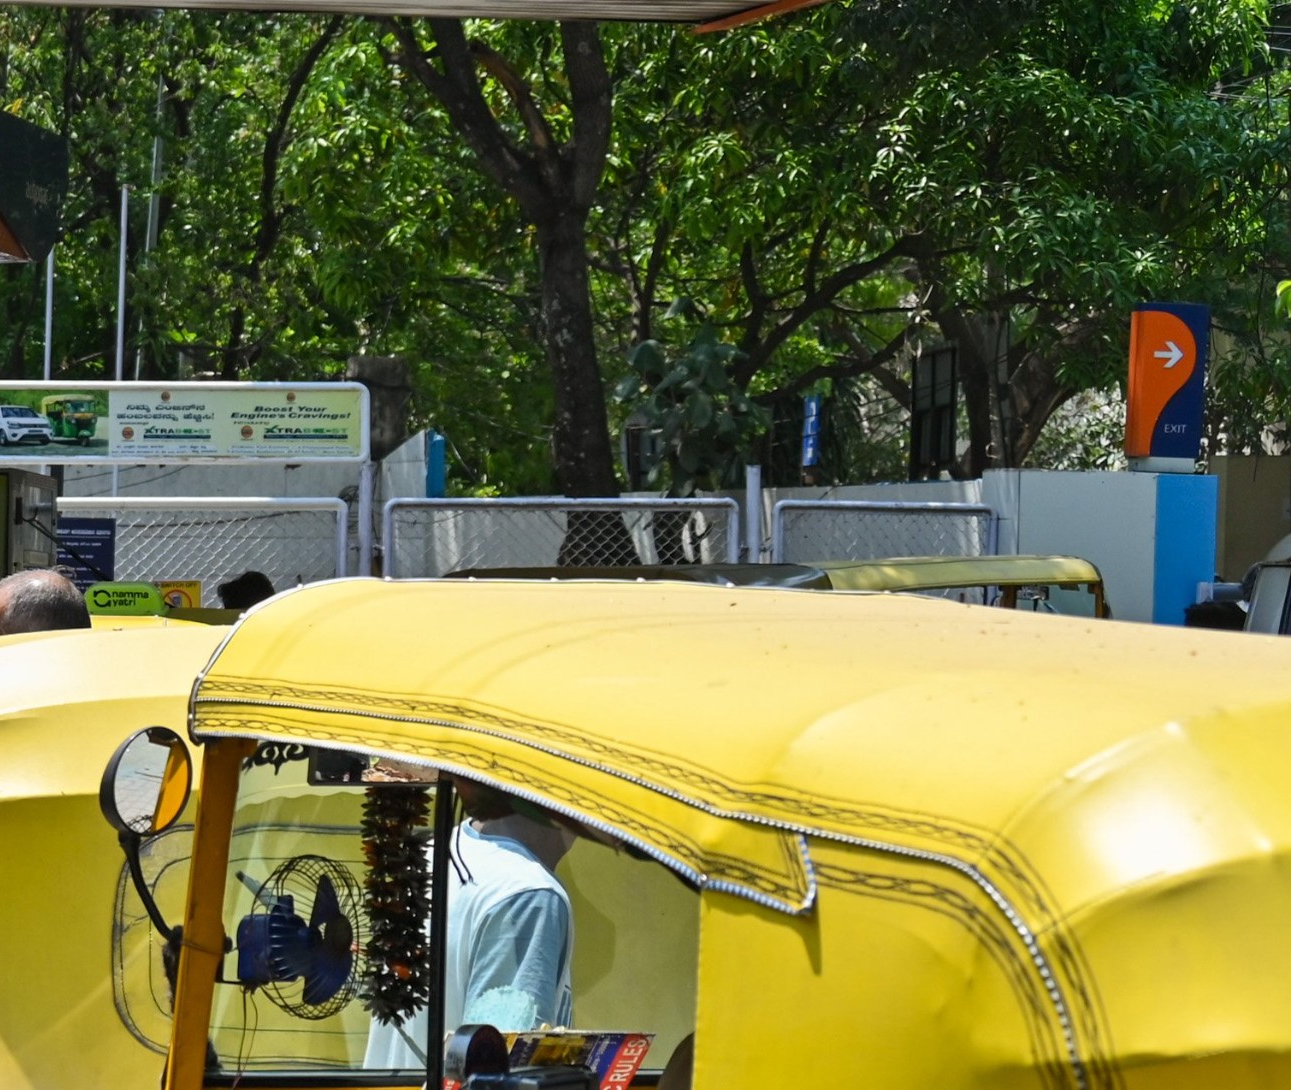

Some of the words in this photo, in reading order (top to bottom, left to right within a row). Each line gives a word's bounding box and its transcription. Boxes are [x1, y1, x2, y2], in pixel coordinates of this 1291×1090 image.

[230, 412, 286, 420] Engine's
[288, 412, 351, 420] Cravings!
[1164, 424, 1186, 434] EXIT
[112, 590, 149, 599] namma
[113, 598, 136, 607] yatri
[609, 1040, 648, 1082] RULES
